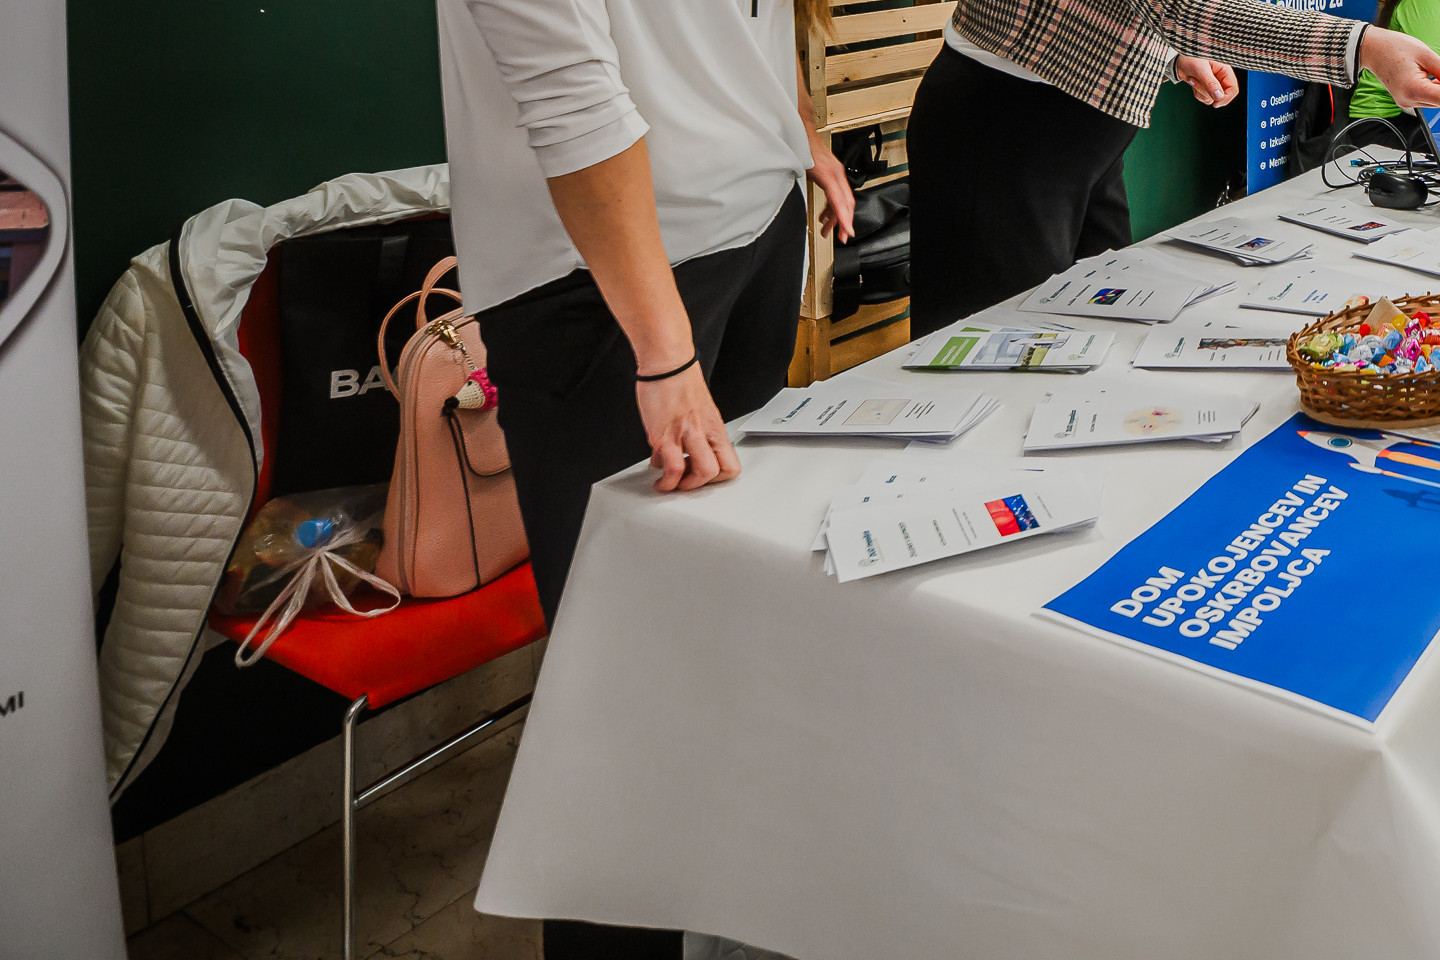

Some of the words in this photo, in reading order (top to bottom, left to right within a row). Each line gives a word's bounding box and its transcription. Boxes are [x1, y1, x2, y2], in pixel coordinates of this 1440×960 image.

[1269, 112, 1294, 127] Praktično
[1270, 92, 1289, 106] Osebni
[330, 365, 399, 399] BA
[1142, 490, 1305, 628] UPOKOJENCEV
[1293, 473, 1328, 496] IN
[1178, 485, 1349, 638] OSKRBOVANCEV
[1109, 565, 1185, 619] DOM
[1208, 548, 1332, 651] IMPOLJCA
